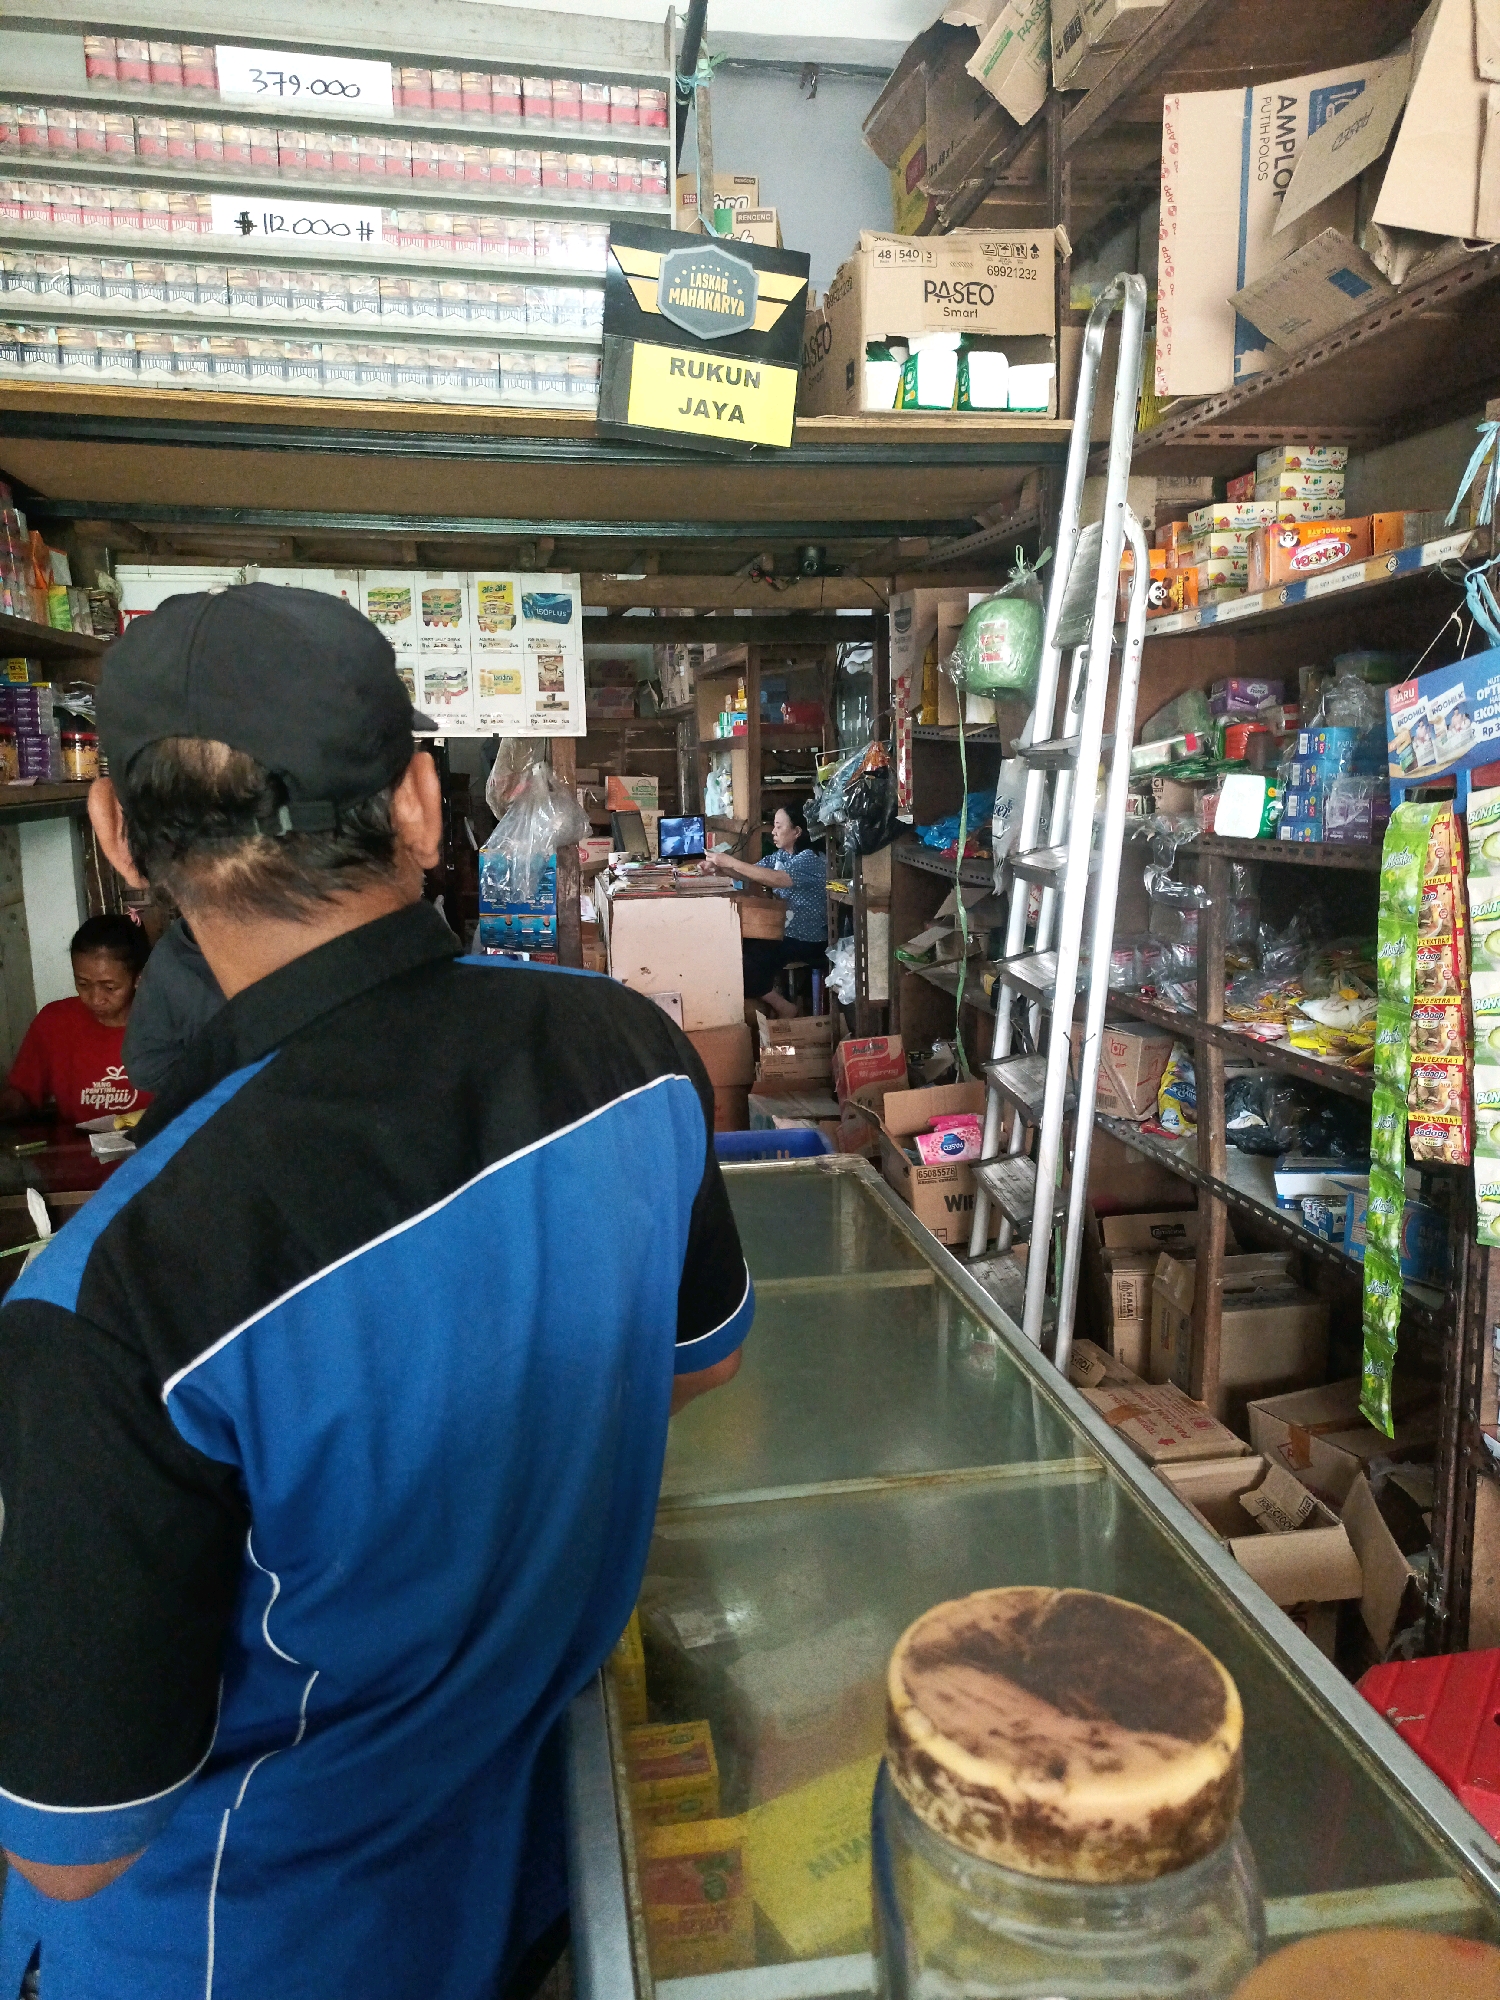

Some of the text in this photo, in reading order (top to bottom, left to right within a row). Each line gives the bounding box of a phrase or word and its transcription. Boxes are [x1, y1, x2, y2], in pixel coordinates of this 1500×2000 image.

[248, 68, 362, 98] 379.000
[877, 250, 892, 259] 48
[898, 249, 920, 259] 540
[986, 265, 1037, 281] 69921232
[689, 272, 729, 294] LASKAR
[923, 279, 995, 306] PASEO
[668, 288, 745, 317] MAHAKARYA
[943, 306, 978, 319] Smart
[669, 356, 761, 389] RUKUN
[678, 397, 746, 425] JAYA
[1308, 445, 1327, 458] Yupi
[1303, 475, 1322, 486] Yupi
[1236, 504, 1254, 516] Yupi
[1302, 502, 1322, 513] Yupi
[1307, 526, 1352, 538] CHOCOLATE
[1392, 687, 1415, 705] BARU
[1482, 725, 1494, 736] Rp
[1412, 1010, 1445, 1020] Sedaap
[1414, 1068, 1446, 1080] Sedaap
[1432, 1115, 1455, 1124] EXTRA
[1414, 1126, 1448, 1139] Sedaap
[942, 1141, 964, 1151] PASEO
[1126, 1291, 1134, 1318] HALAL
